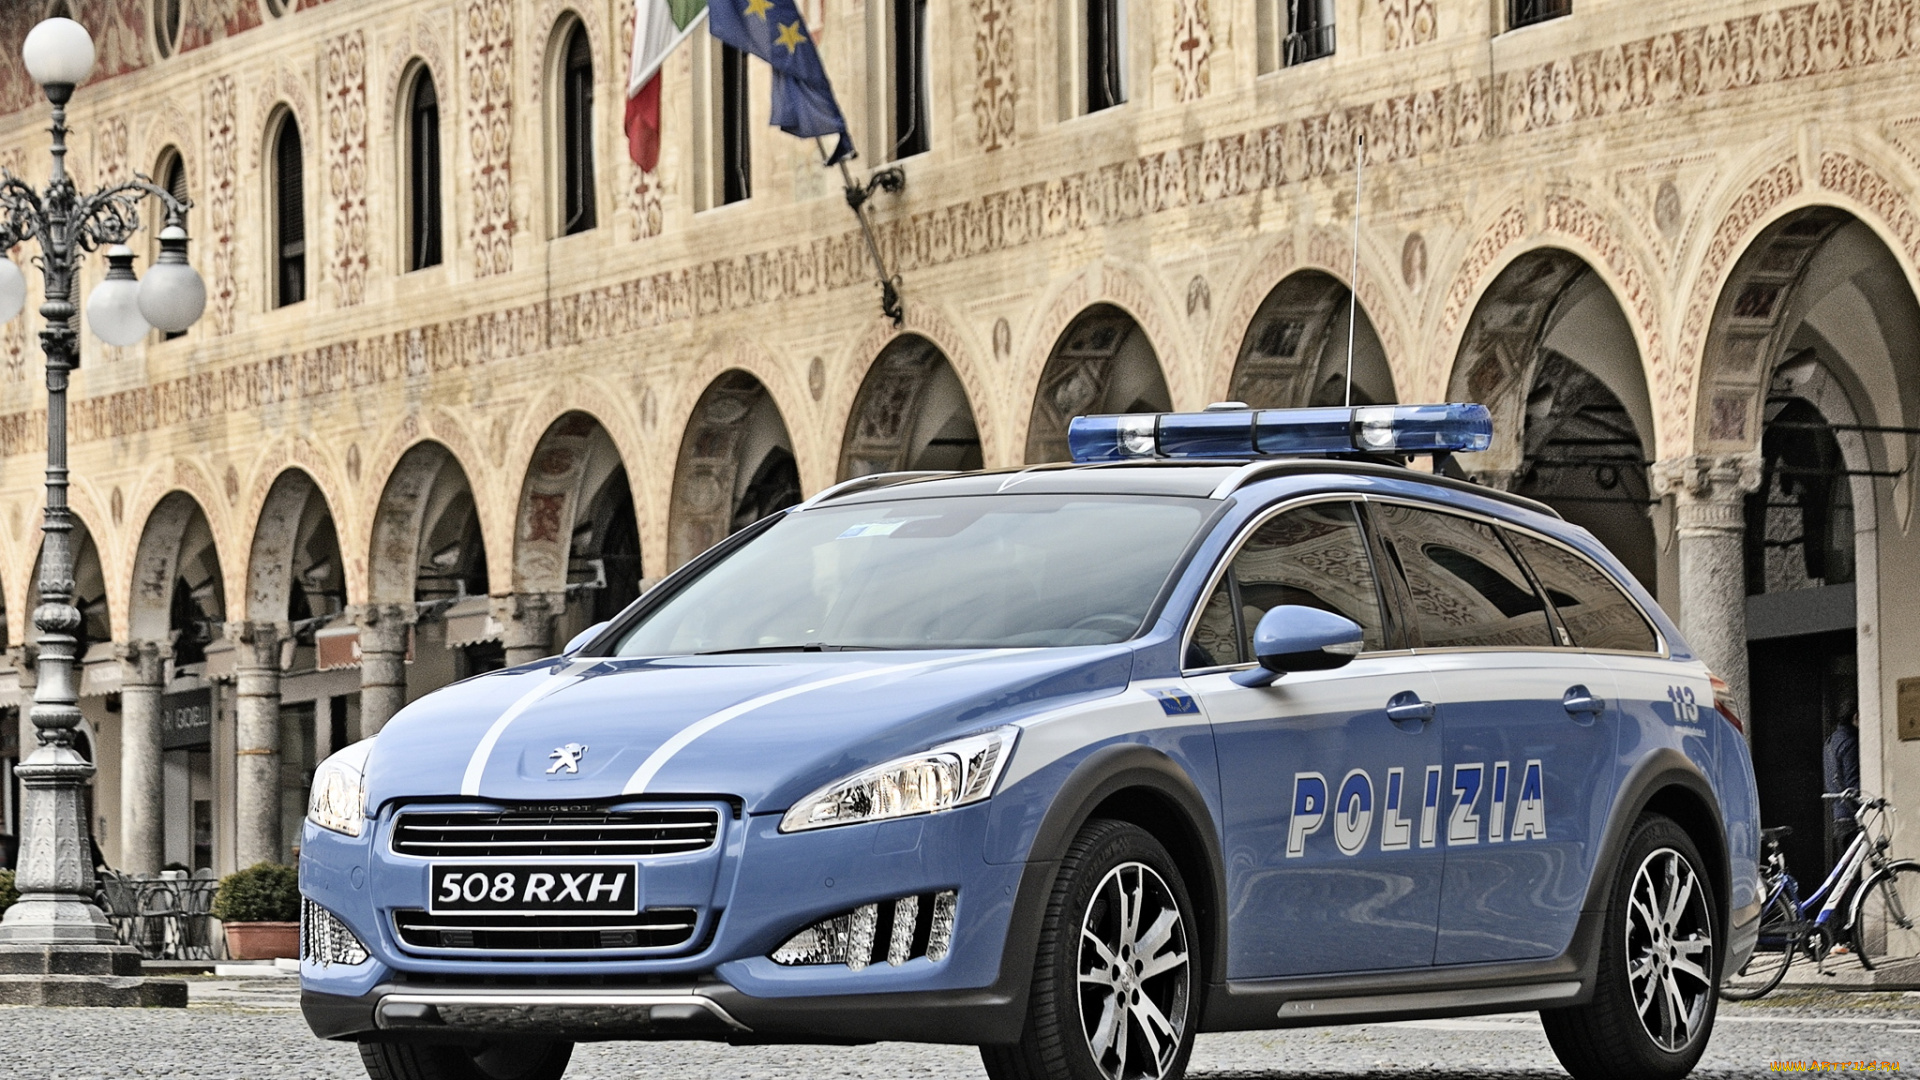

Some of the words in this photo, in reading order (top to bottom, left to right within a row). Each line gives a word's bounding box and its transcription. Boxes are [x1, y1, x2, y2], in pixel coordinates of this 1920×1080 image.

[1667, 685, 1699, 723] 113
[519, 804, 592, 812] PEUGEOT
[1286, 759, 1547, 858] POLIZIA
[438, 872, 516, 902] 508
[522, 872, 628, 903] RXH
